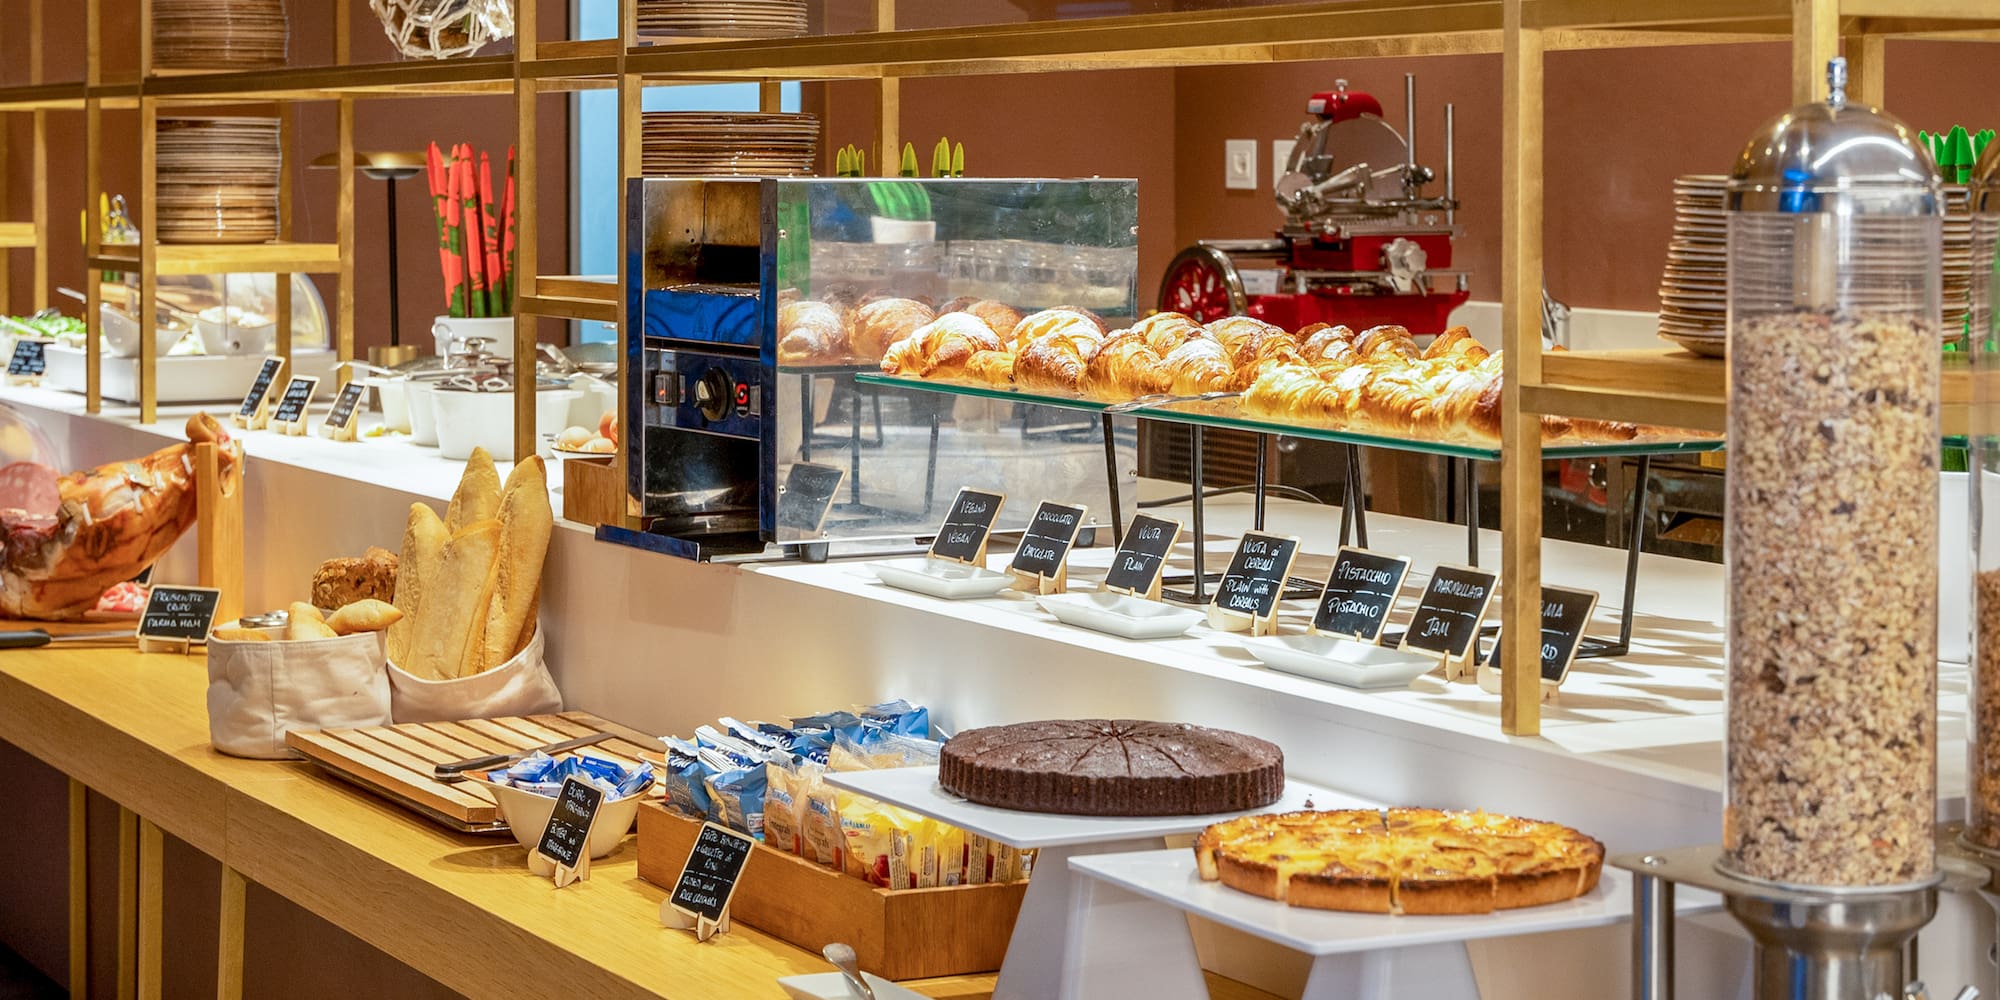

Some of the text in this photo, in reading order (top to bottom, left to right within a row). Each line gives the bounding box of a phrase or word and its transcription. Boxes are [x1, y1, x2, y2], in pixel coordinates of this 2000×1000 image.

[947, 530, 976, 544] VEGAN
[1123, 556, 1150, 571] PLAIN
[1338, 560, 1392, 585] PISTACCHIO
[1226, 579, 1254, 593] PLAIN
[1229, 594, 1260, 609] CEREALS
[1328, 597, 1379, 618] PISTACHIO
[147, 618, 201, 628] PARMA HAM
[1421, 616, 1450, 637] JAM
